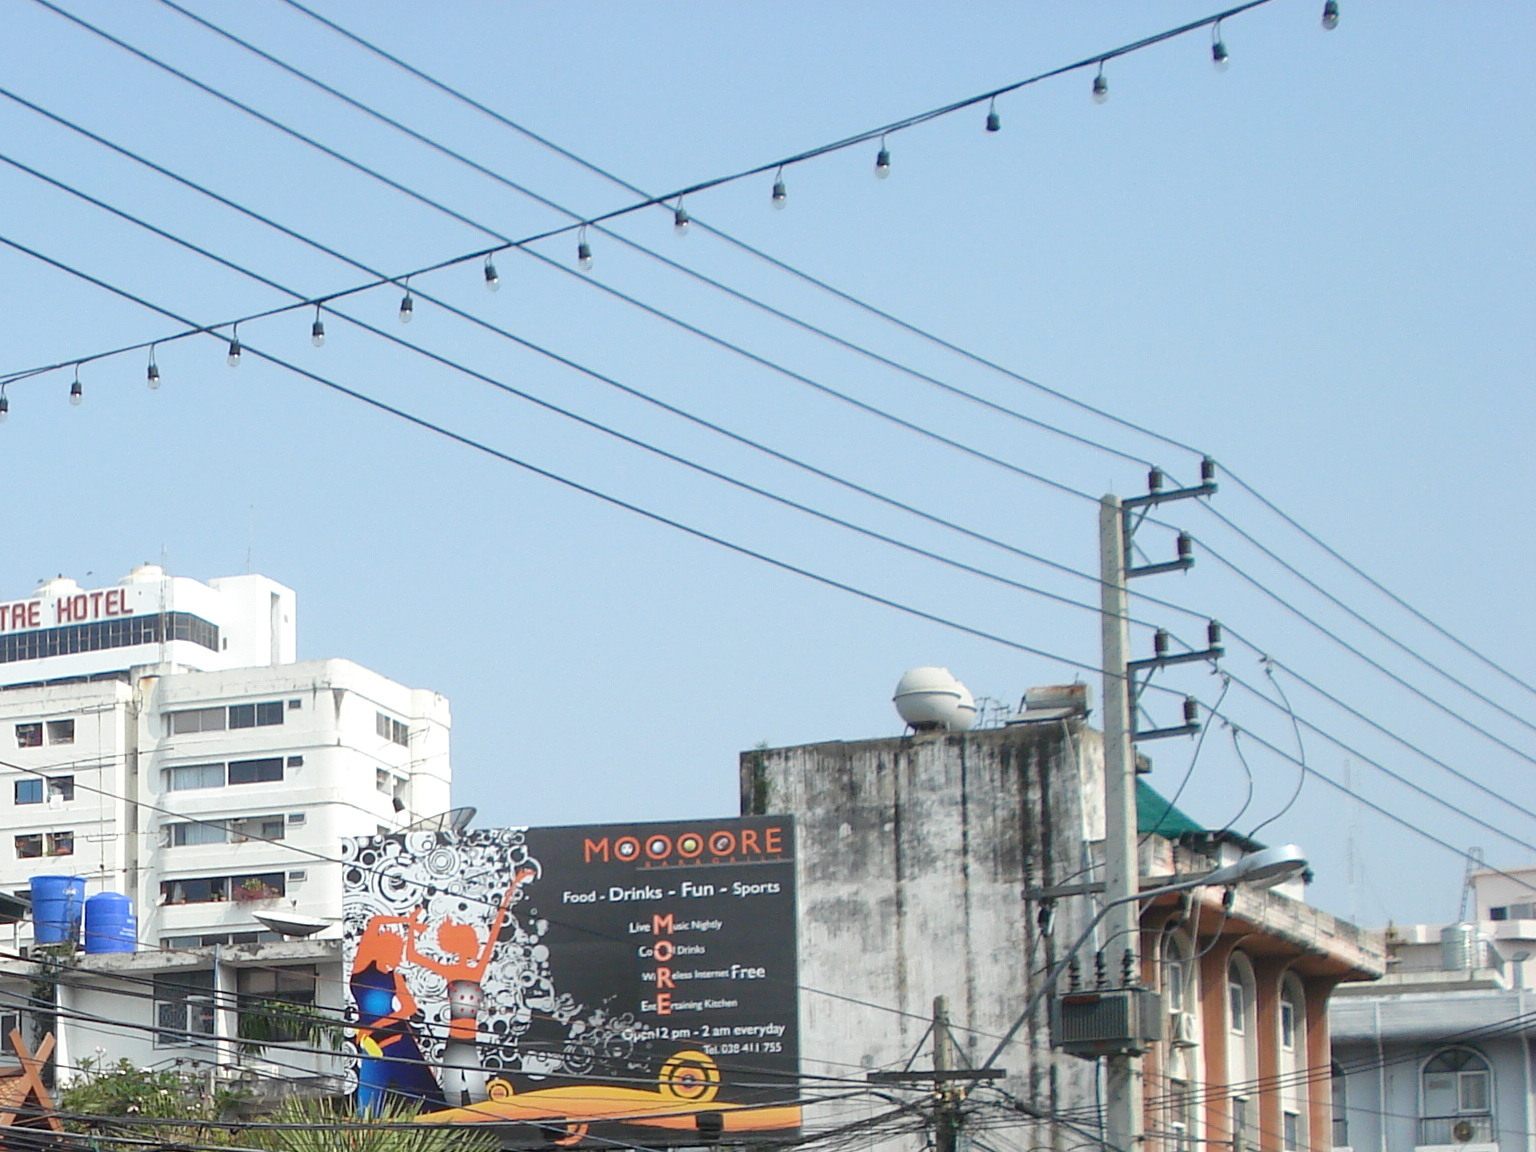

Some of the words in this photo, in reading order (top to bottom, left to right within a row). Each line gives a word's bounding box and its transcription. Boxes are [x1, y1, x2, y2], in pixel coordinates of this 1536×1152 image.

[57, 588, 134, 624] HOTEL
[583, 828, 782, 863] MOOOORE
[563, 890, 597, 904] Food
[609, 884, 663, 902] Drinks
[681, 881, 715, 898] Fun
[732, 880, 781, 897] Sports
[628, 922, 652, 934] Live
[677, 944, 706, 955] Drinks
[730, 964, 766, 980] Free
[671, 1030, 691, 1041] pm
[701, 1025, 710, 1037] 2
[713, 1027, 731, 1037] am
[733, 1022, 786, 1038] everyday
